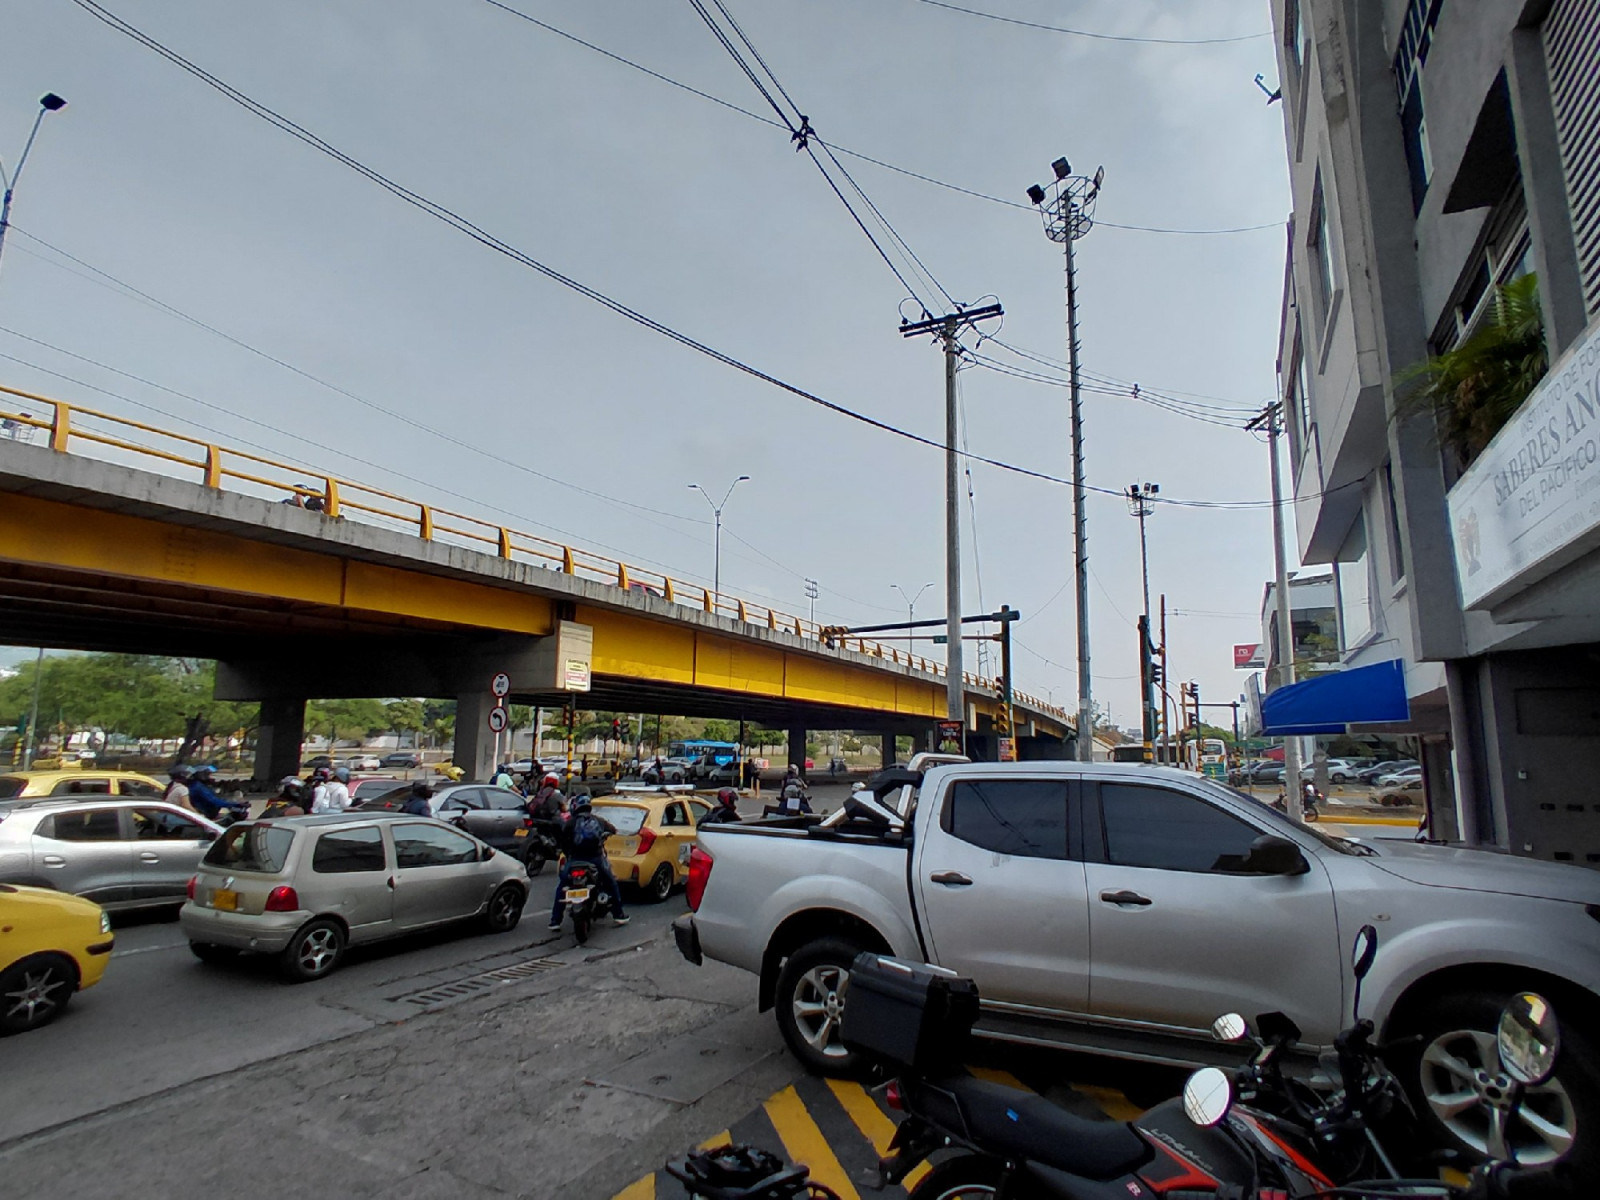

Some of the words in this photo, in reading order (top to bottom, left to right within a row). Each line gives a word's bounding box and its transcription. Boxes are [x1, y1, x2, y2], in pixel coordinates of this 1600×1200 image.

[1520, 382, 1563, 437] INSTITUTO
[1562, 362, 1579, 393] DE
[1493, 415, 1562, 507] SABERES
[1519, 488, 1541, 518] DEL
